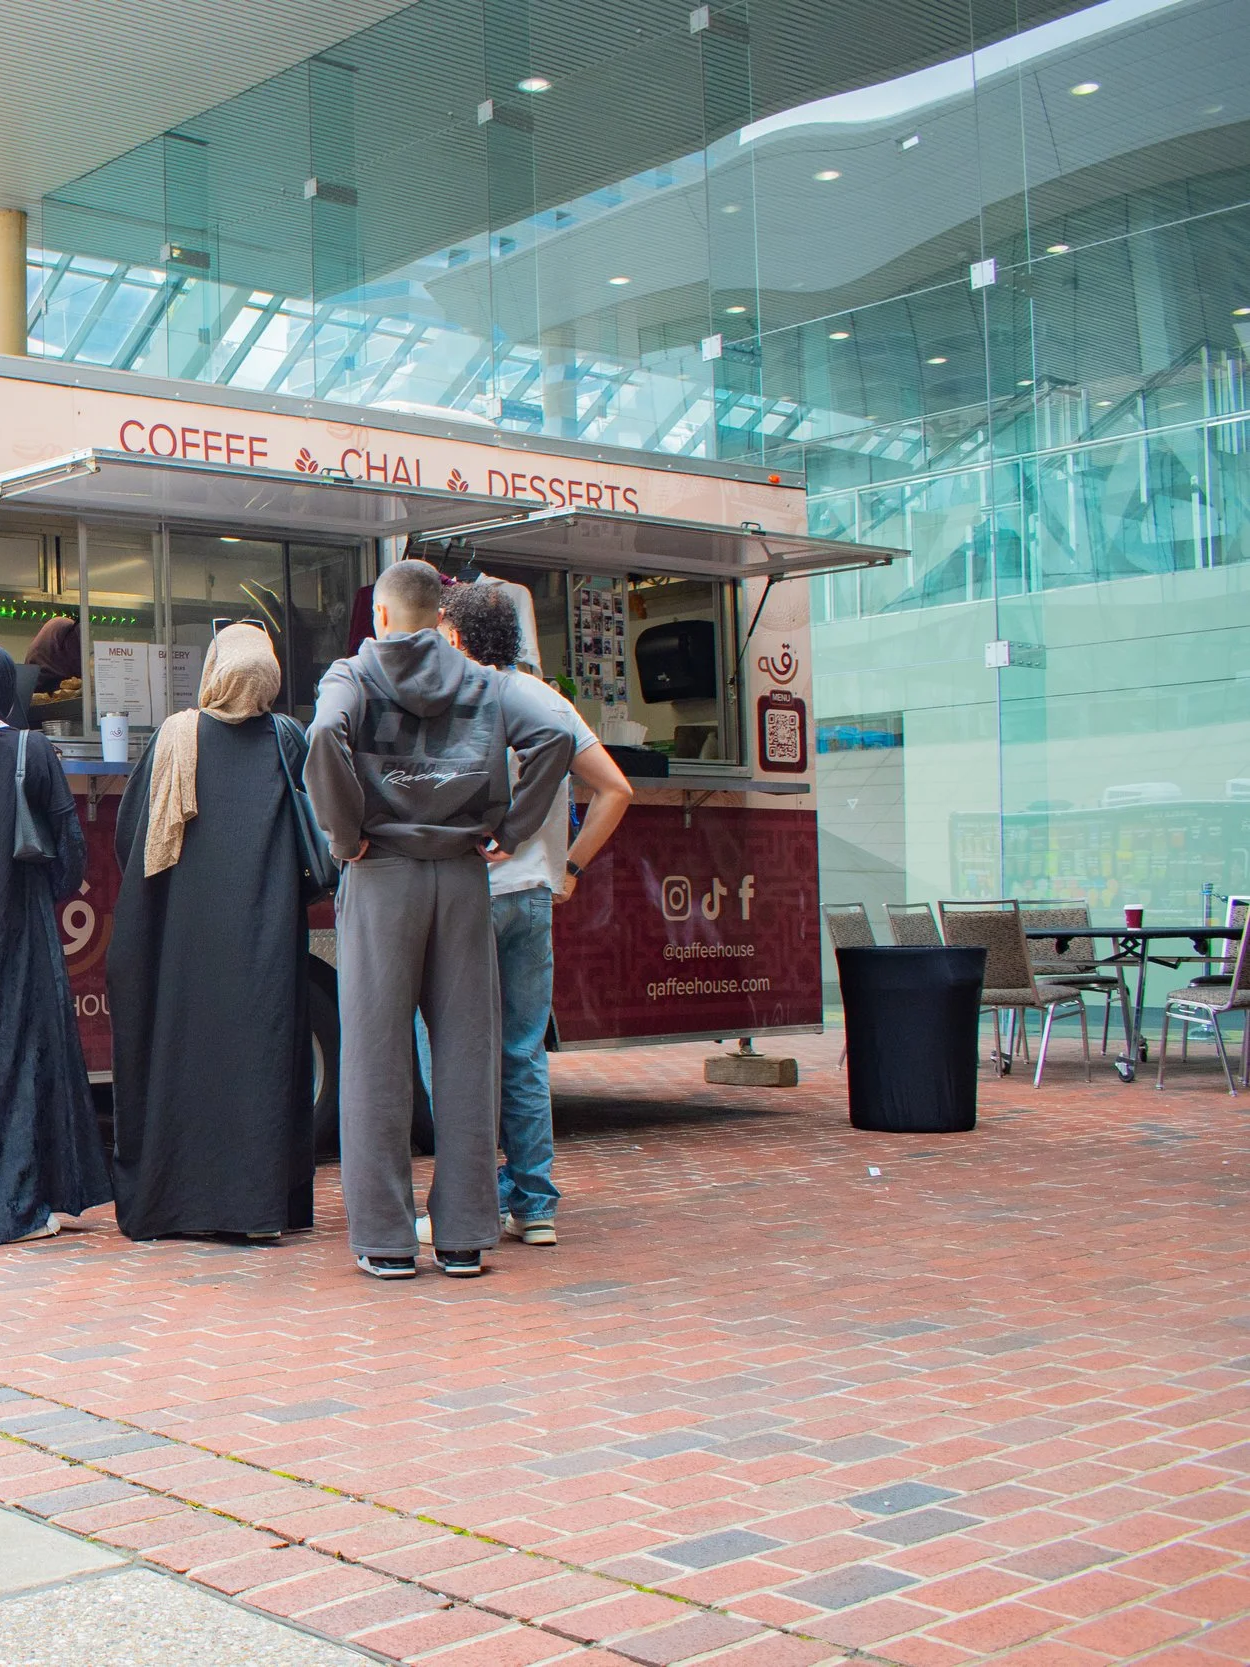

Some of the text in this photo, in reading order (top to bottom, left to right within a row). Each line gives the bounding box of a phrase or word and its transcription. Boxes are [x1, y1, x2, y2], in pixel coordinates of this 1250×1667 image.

[341, 449, 420, 486] CHAI
[488, 470, 638, 514] DESSERTS
[109, 648, 133, 656] MENU
[772, 693, 790, 701] MENU
[382, 769, 489, 789] Racing
[663, 942, 755, 962] @qaffeehouse
[647, 977, 770, 1000] qaffeehouse.com
